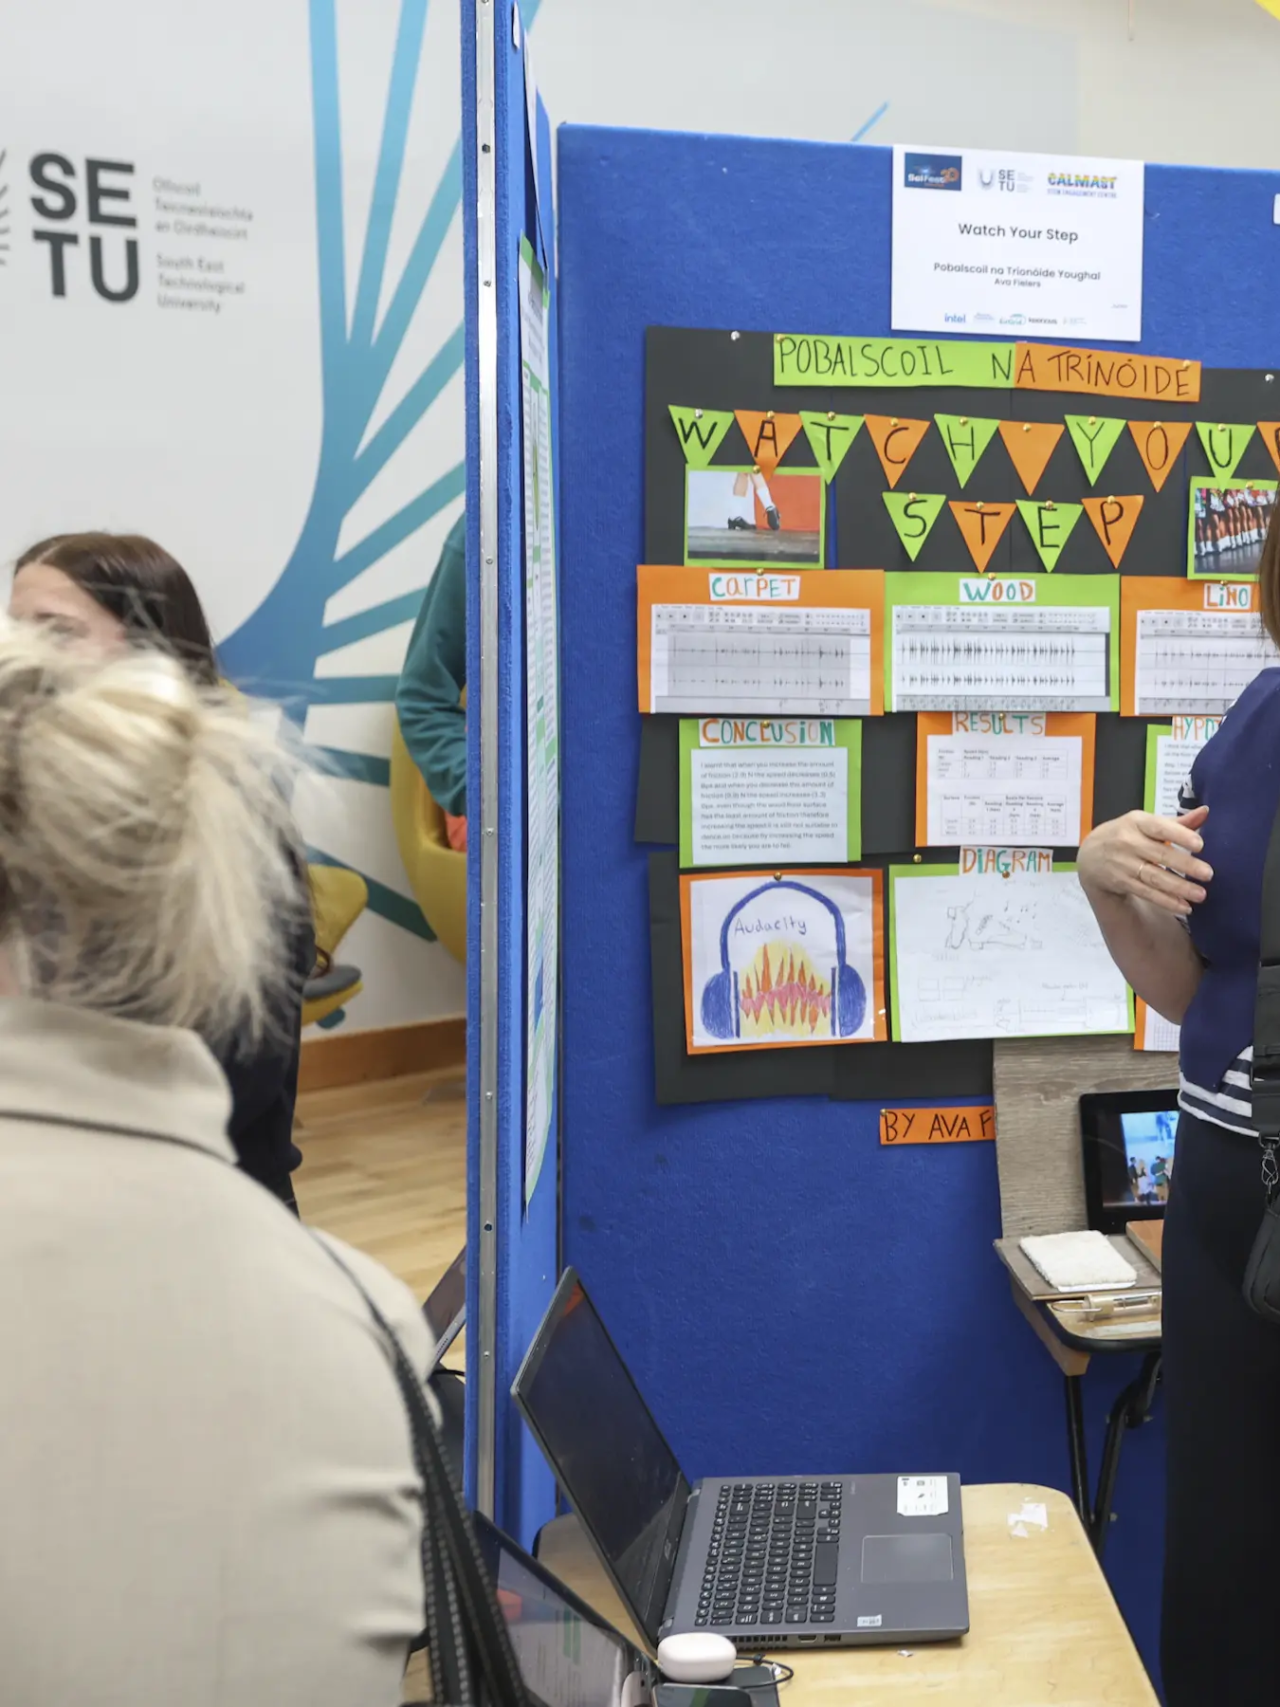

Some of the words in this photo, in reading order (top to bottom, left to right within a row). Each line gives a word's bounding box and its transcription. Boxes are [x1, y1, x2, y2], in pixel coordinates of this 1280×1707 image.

[999, 169, 1015, 180] SE
[1048, 172, 1116, 189] CALMAST
[29, 150, 137, 228] SE
[999, 181, 1015, 192] TU
[958, 223, 1006, 237] Watch
[1010, 227, 1042, 240] Your
[1046, 229, 1079, 244] Step
[33, 228, 140, 303] TU
[934, 262, 988, 274] Pobalscoil
[991, 267, 1004, 275] na
[1058, 270, 1101, 282] Youghal
[994, 278, 1011, 286] Ava
[944, 313, 966, 324] intel
[780, 337, 953, 377] POBALSCOIL
[679, 418, 975, 465] WATCH
[903, 499, 1125, 550] STEP
[962, 580, 1034, 601] WOOD
[955, 712, 1044, 735] RESULTS
[734, 915, 807, 937] Audacity
[885, 1111, 915, 1142] BY
[928, 1113, 971, 1140] AVA
